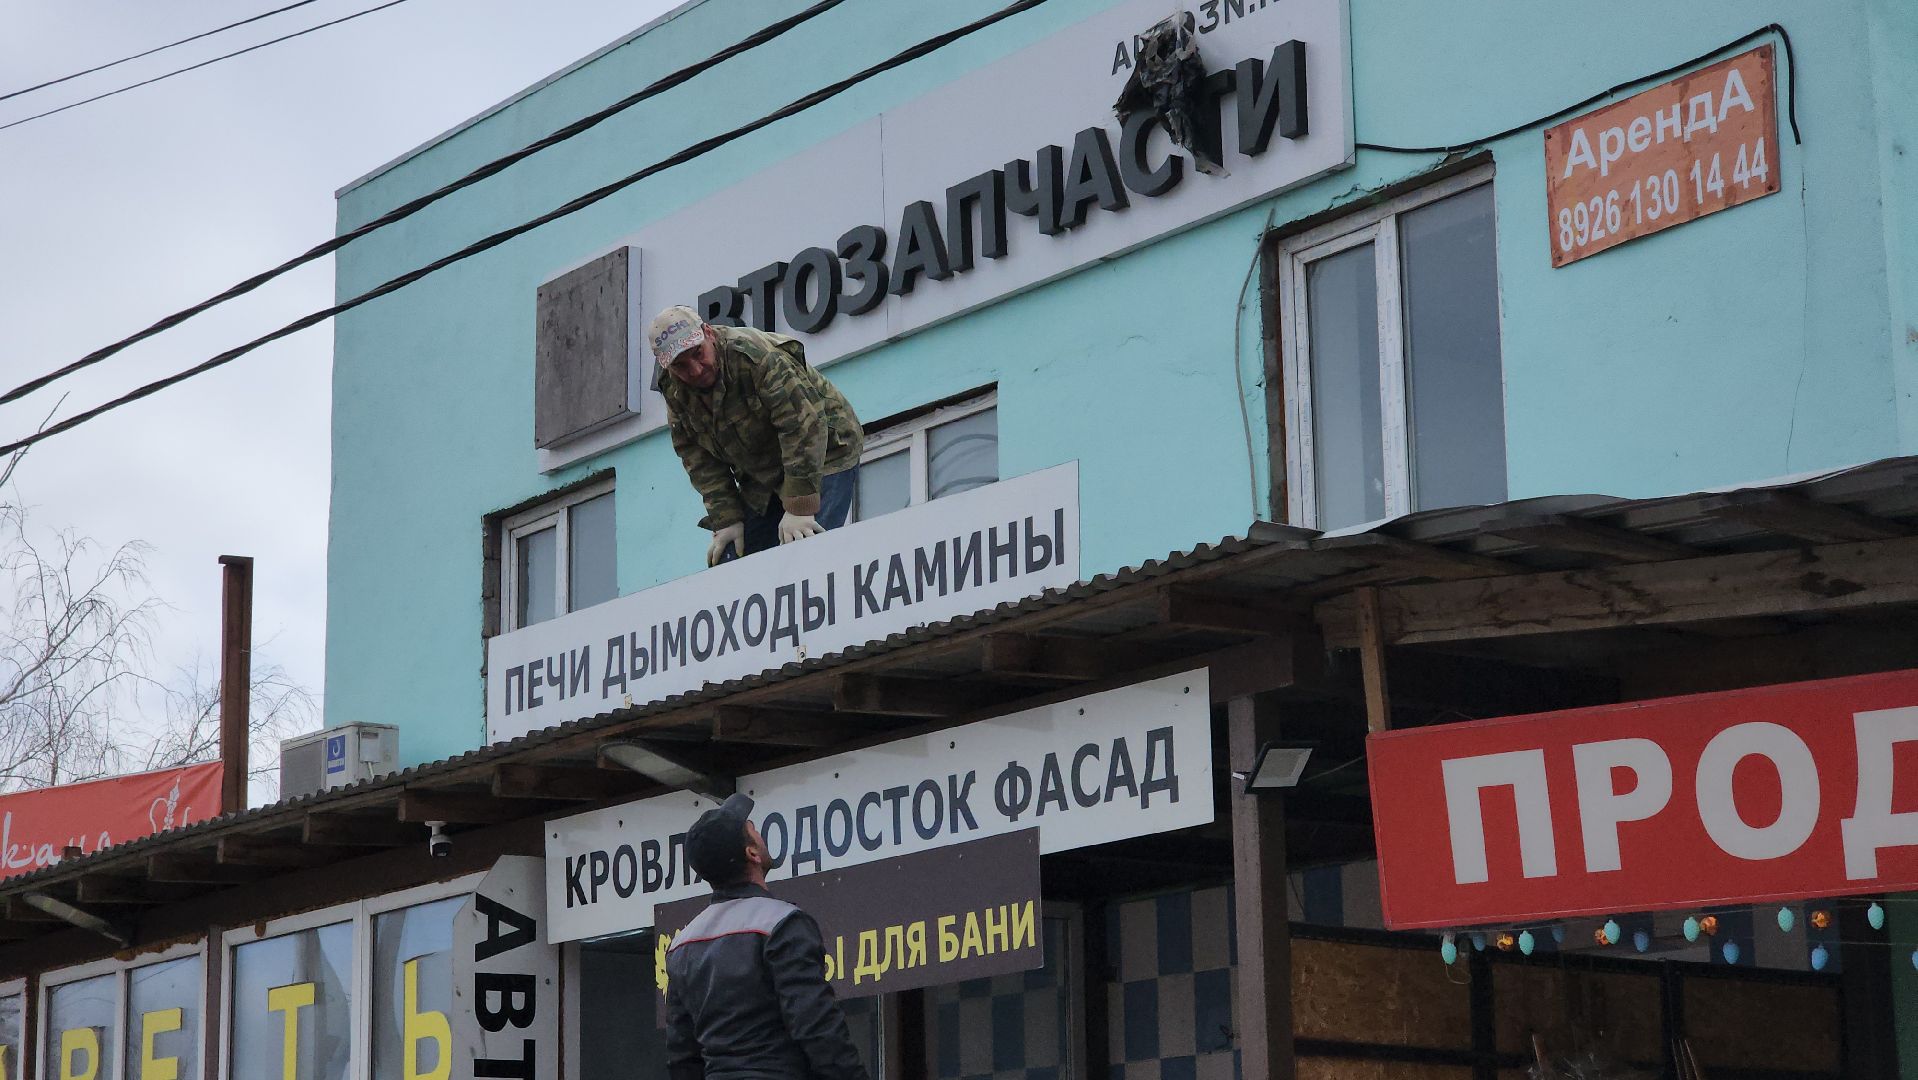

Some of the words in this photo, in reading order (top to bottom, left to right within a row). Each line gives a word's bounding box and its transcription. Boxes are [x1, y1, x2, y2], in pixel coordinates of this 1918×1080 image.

[1558, 189, 1622, 253] 8926
[1629, 168, 1680, 225] 130
[1689, 152, 1724, 205] 14
[1732, 137, 1769, 190] 44
[1562, 68, 1755, 179] АрендА
[650, 39, 1309, 392] ВТОЗАПЧАСТИ
[504, 644, 590, 716] ПЕЧИ
[602, 571, 836, 699] ДЫМОХОДЫ
[853, 508, 1066, 619] КАМИНЫ
[565, 831, 704, 909] КРОВЛ
[761, 769, 979, 877] ОДОСТОК
[993, 725, 1181, 823] ФАСАД
[1441, 706, 1918, 884] ПРОД
[473, 892, 537, 1080] АВТ
[853, 920, 927, 986] ДЛЯ
[938, 900, 1036, 962] БАНИ
